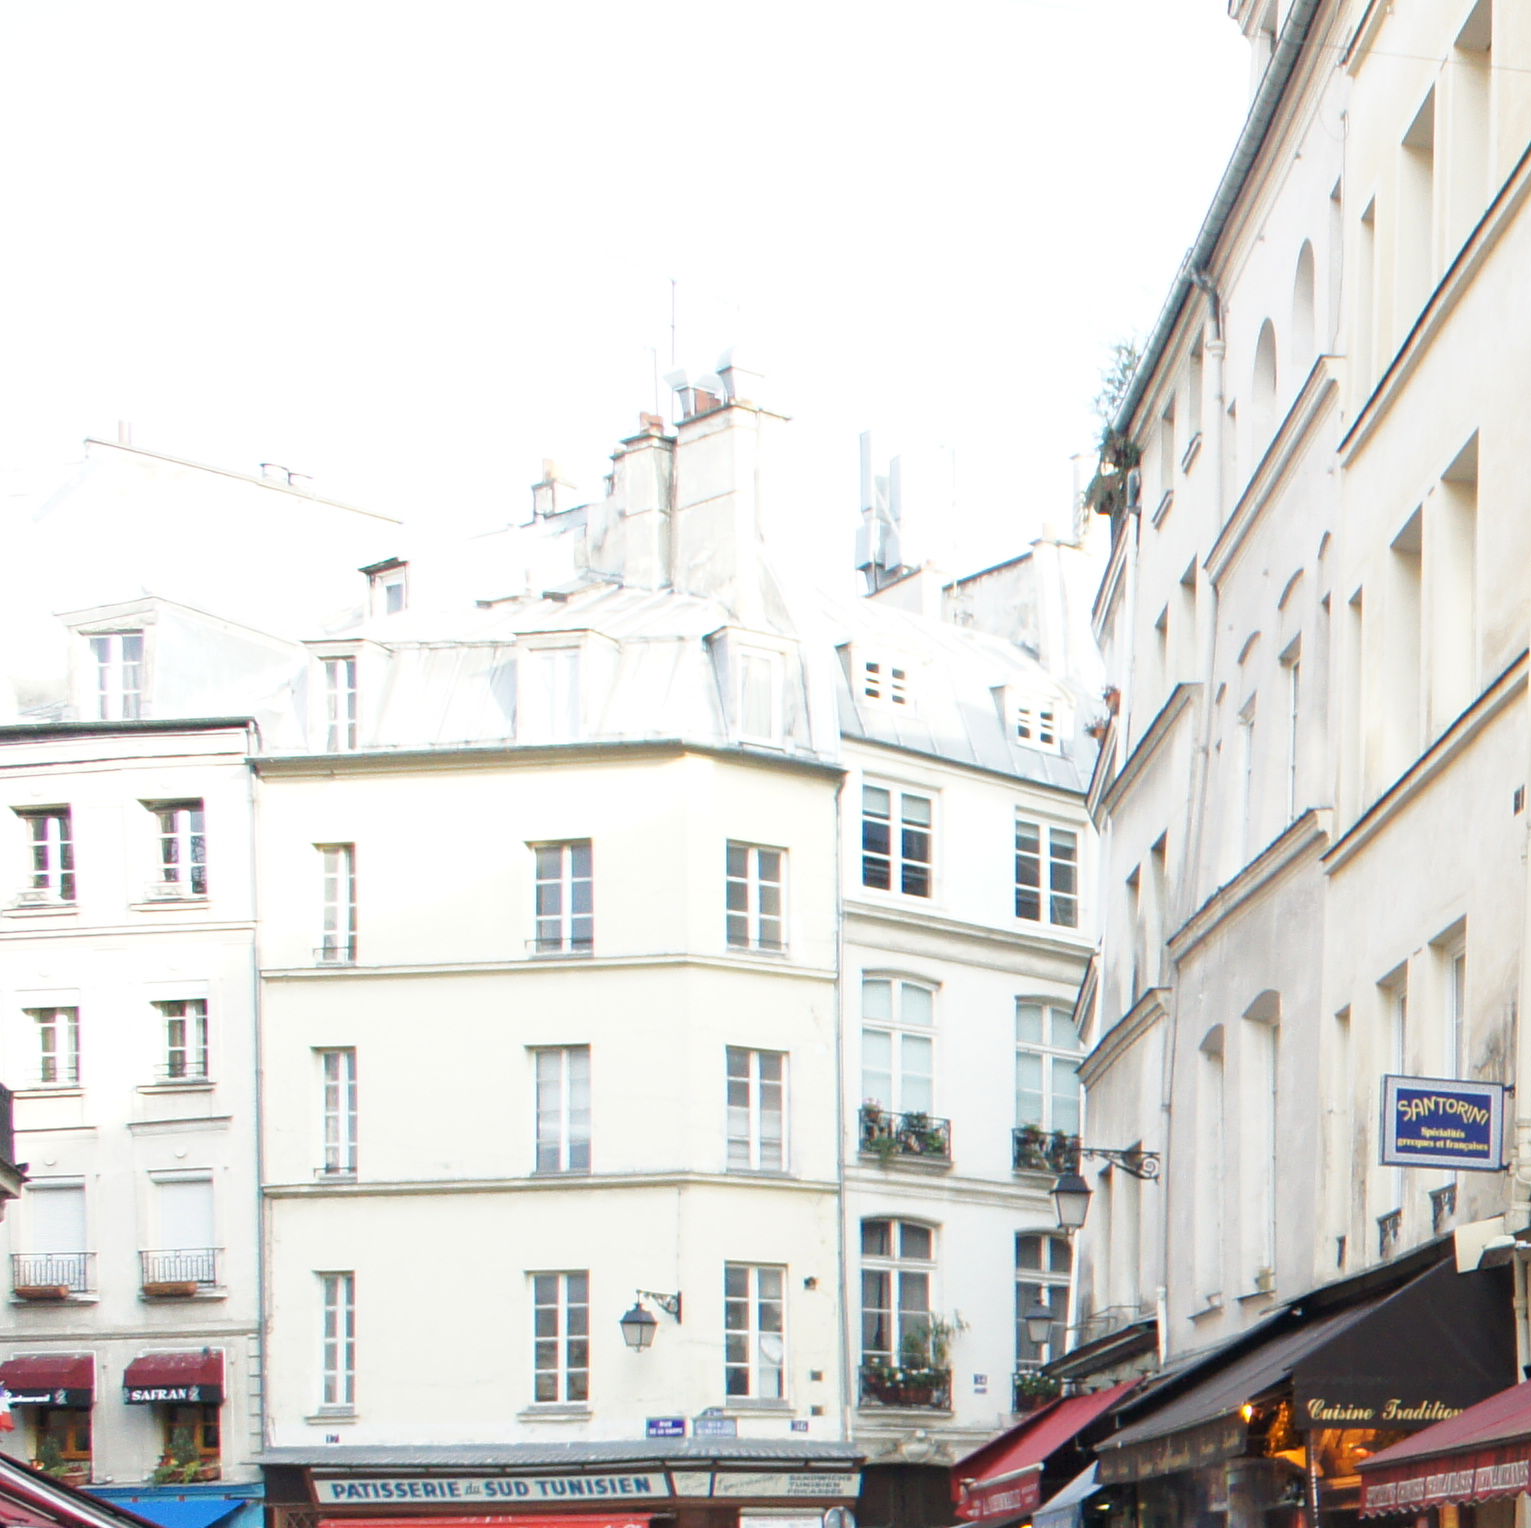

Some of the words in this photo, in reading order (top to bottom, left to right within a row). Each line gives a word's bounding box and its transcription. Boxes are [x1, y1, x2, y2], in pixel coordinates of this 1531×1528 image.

[1397, 1096, 1489, 1126] SANTORINI
[132, 1388, 188, 1401] SAFRAN
[1308, 1399, 1375, 1421] Cuisine
[331, 1481, 462, 1499] PATISSERIE
[465, 1483, 482, 1495] du
[485, 1480, 531, 1497] SUD
[538, 1476, 651, 1496] TUNISIEN
